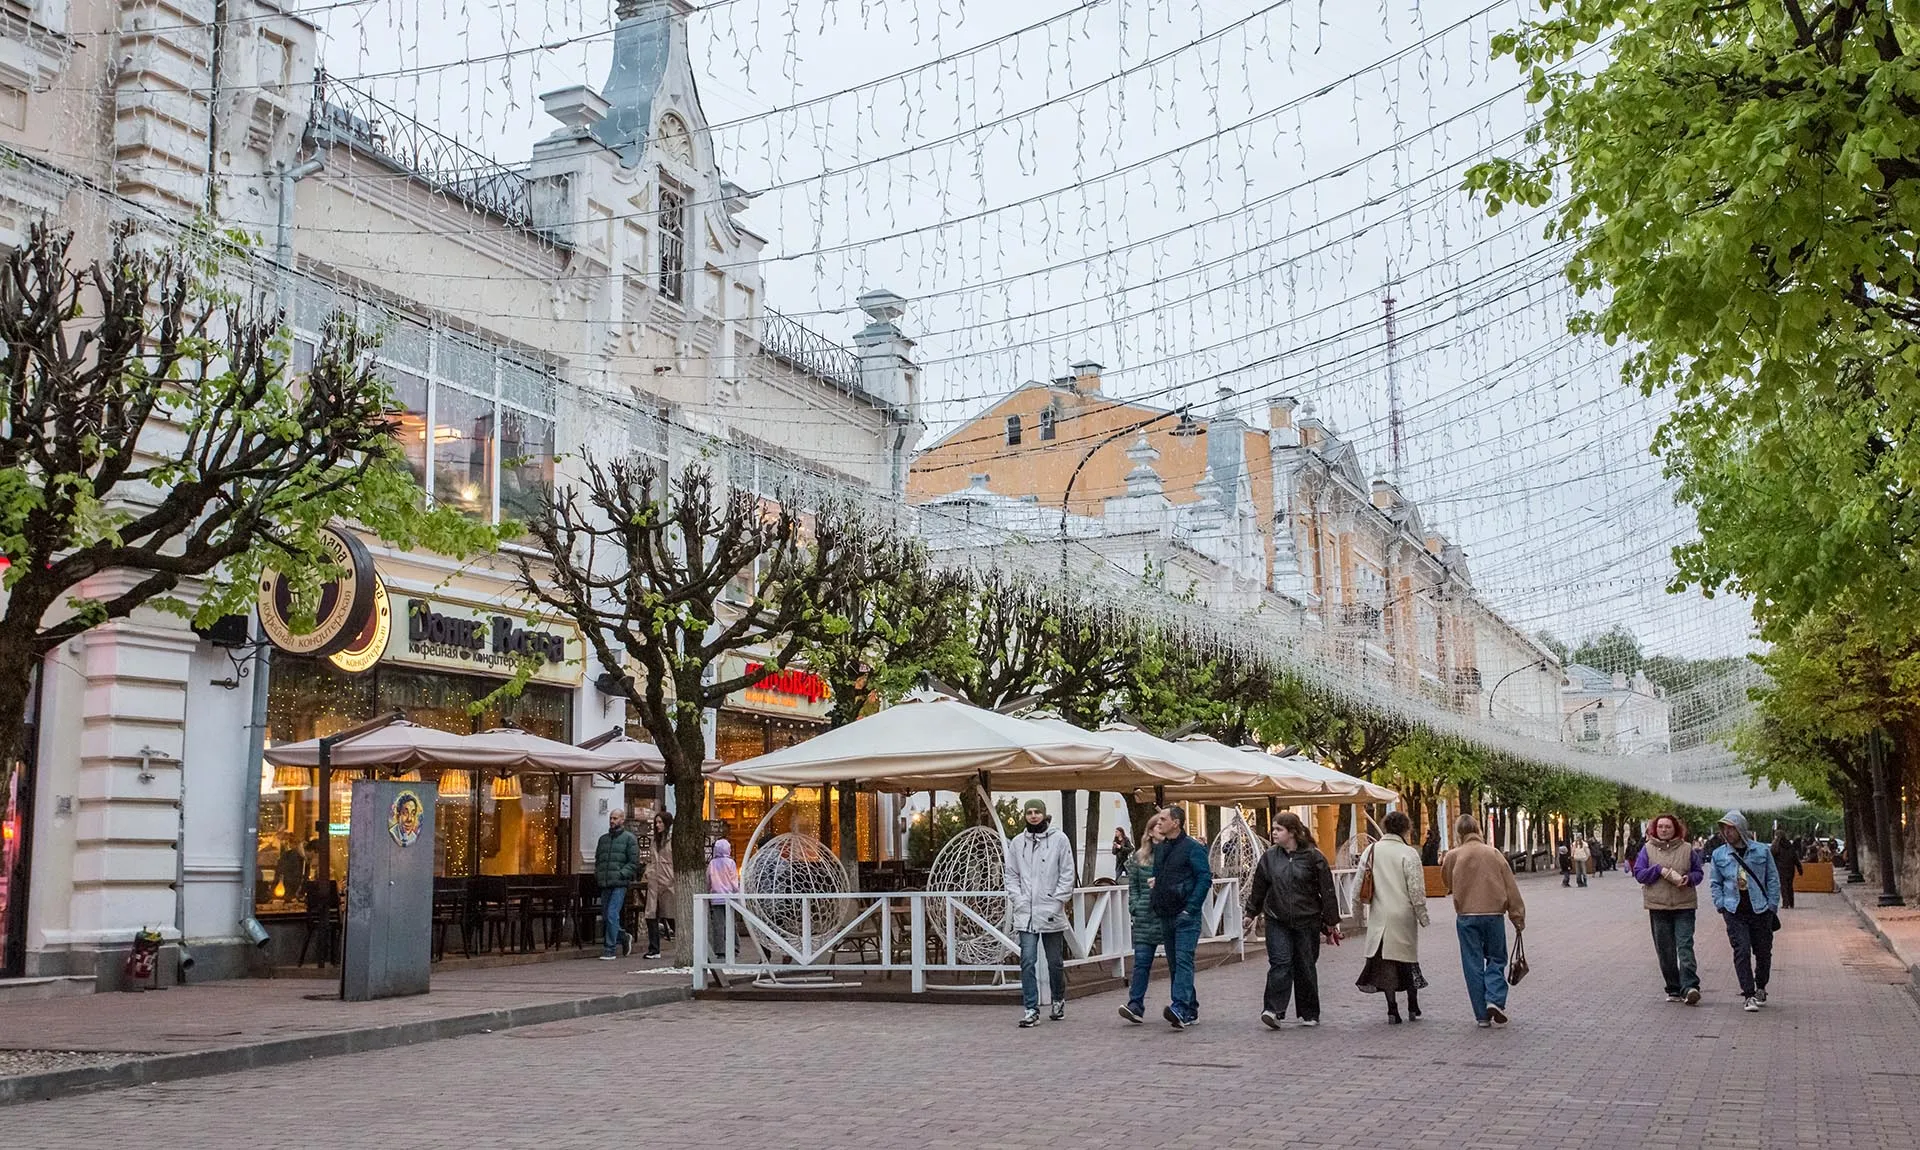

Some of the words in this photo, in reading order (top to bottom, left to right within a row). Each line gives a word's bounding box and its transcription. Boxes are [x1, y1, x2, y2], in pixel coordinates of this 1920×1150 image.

[316, 529, 348, 564] лара
[262, 602, 295, 647] кофейная
[298, 590, 352, 648] кондитерская
[409, 641, 459, 660] кофейная
